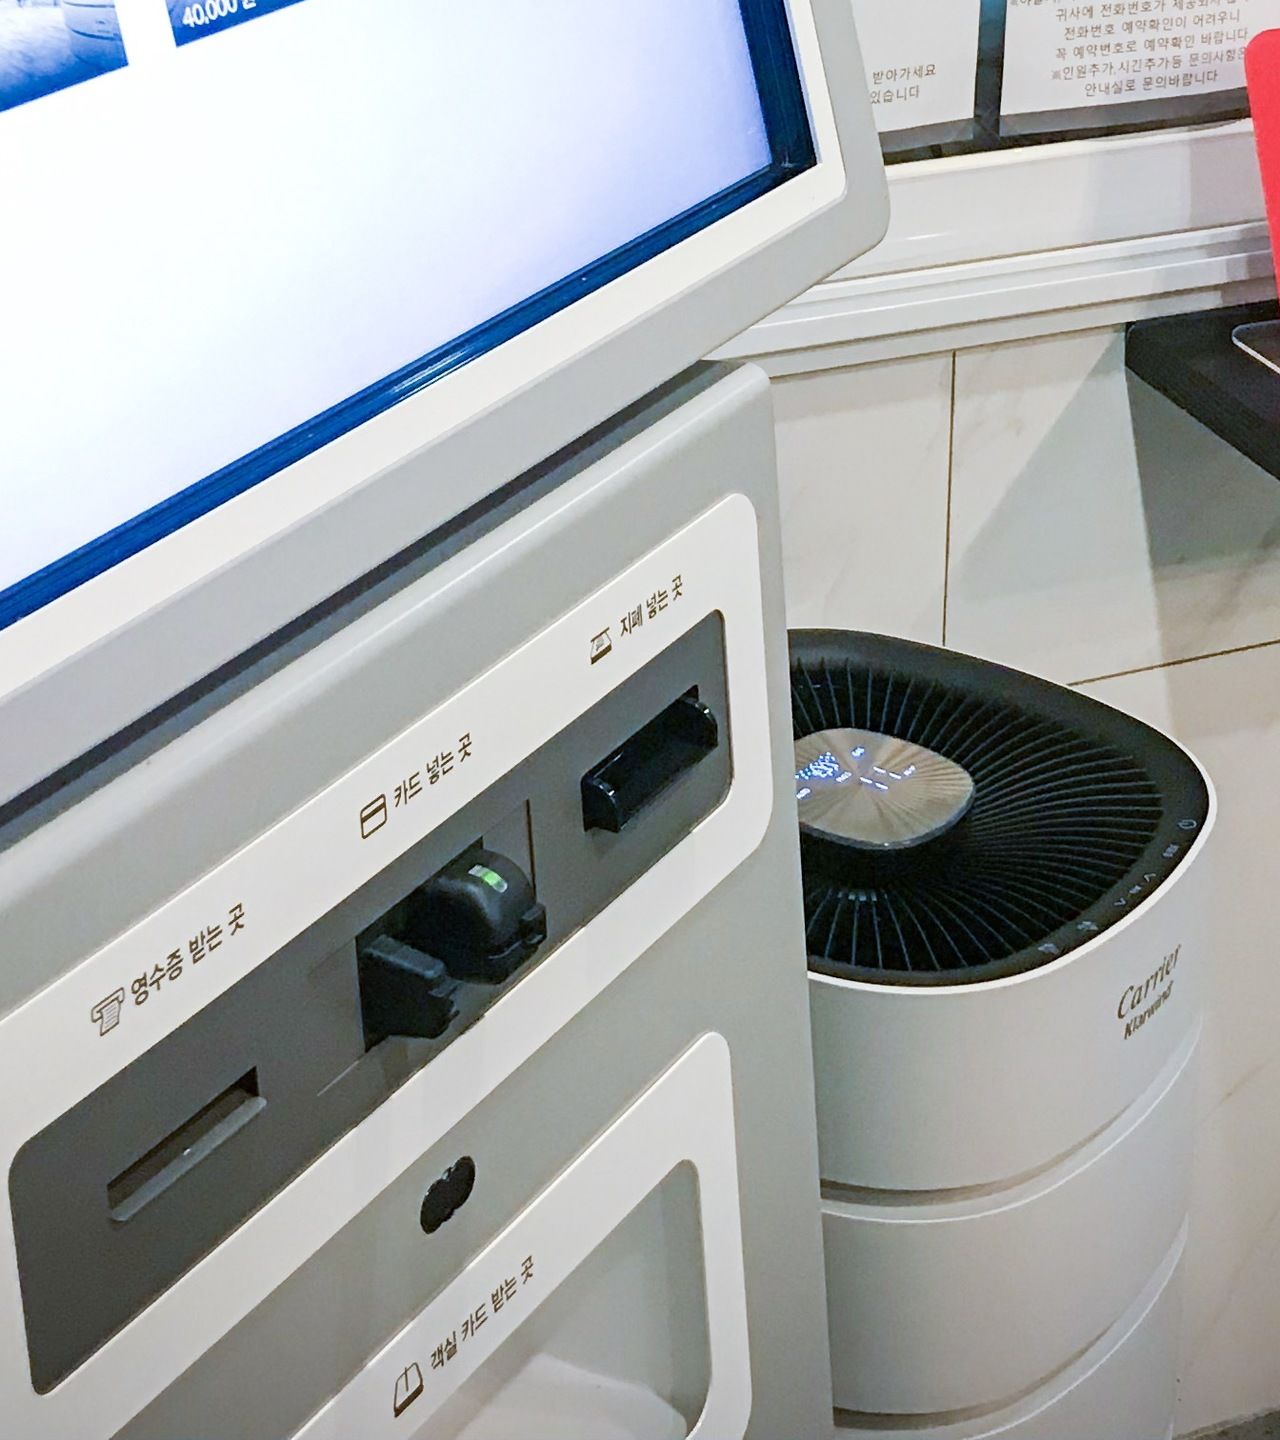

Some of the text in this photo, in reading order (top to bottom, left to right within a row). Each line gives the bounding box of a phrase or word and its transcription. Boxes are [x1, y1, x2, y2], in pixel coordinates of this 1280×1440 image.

[620, 606, 645, 638] 지폐
[392, 731, 474, 810] 카드 넣는 곳
[130, 901, 247, 1006] 영수증 받는 곳
[1117, 943, 1182, 1019] Carrier
[430, 1274, 518, 1371] 객실 카드 받는
